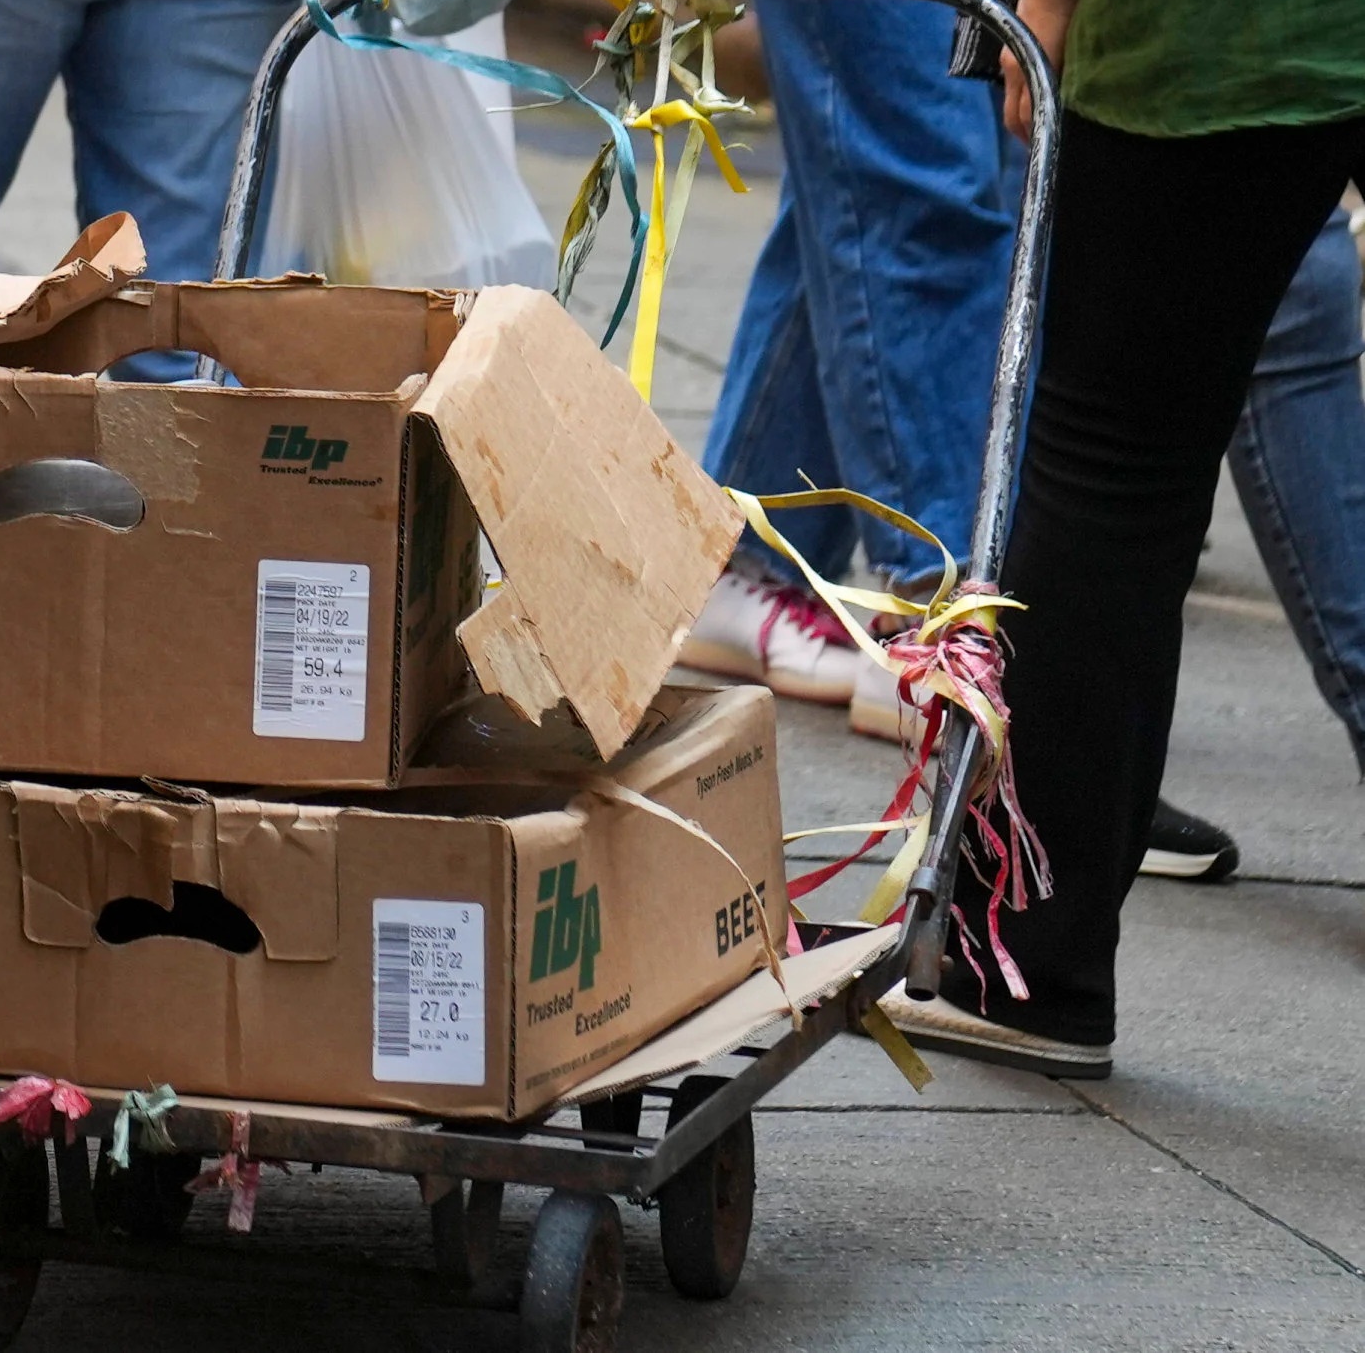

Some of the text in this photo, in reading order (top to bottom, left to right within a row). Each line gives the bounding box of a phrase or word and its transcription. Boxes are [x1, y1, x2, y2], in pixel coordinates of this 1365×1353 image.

[262, 425, 349, 471] ibp
[260, 465, 307, 474] Trusted
[349, 569, 358, 582] 2
[296, 608, 349, 627] 04/19/22
[304, 657, 343, 678] 59.4
[462, 910, 470, 923] 3
[529, 860, 601, 991] ibp
[420, 1000, 460, 1022] 27.0
[527, 988, 573, 1026] Trusted
[575, 992, 631, 1036] Excellence
